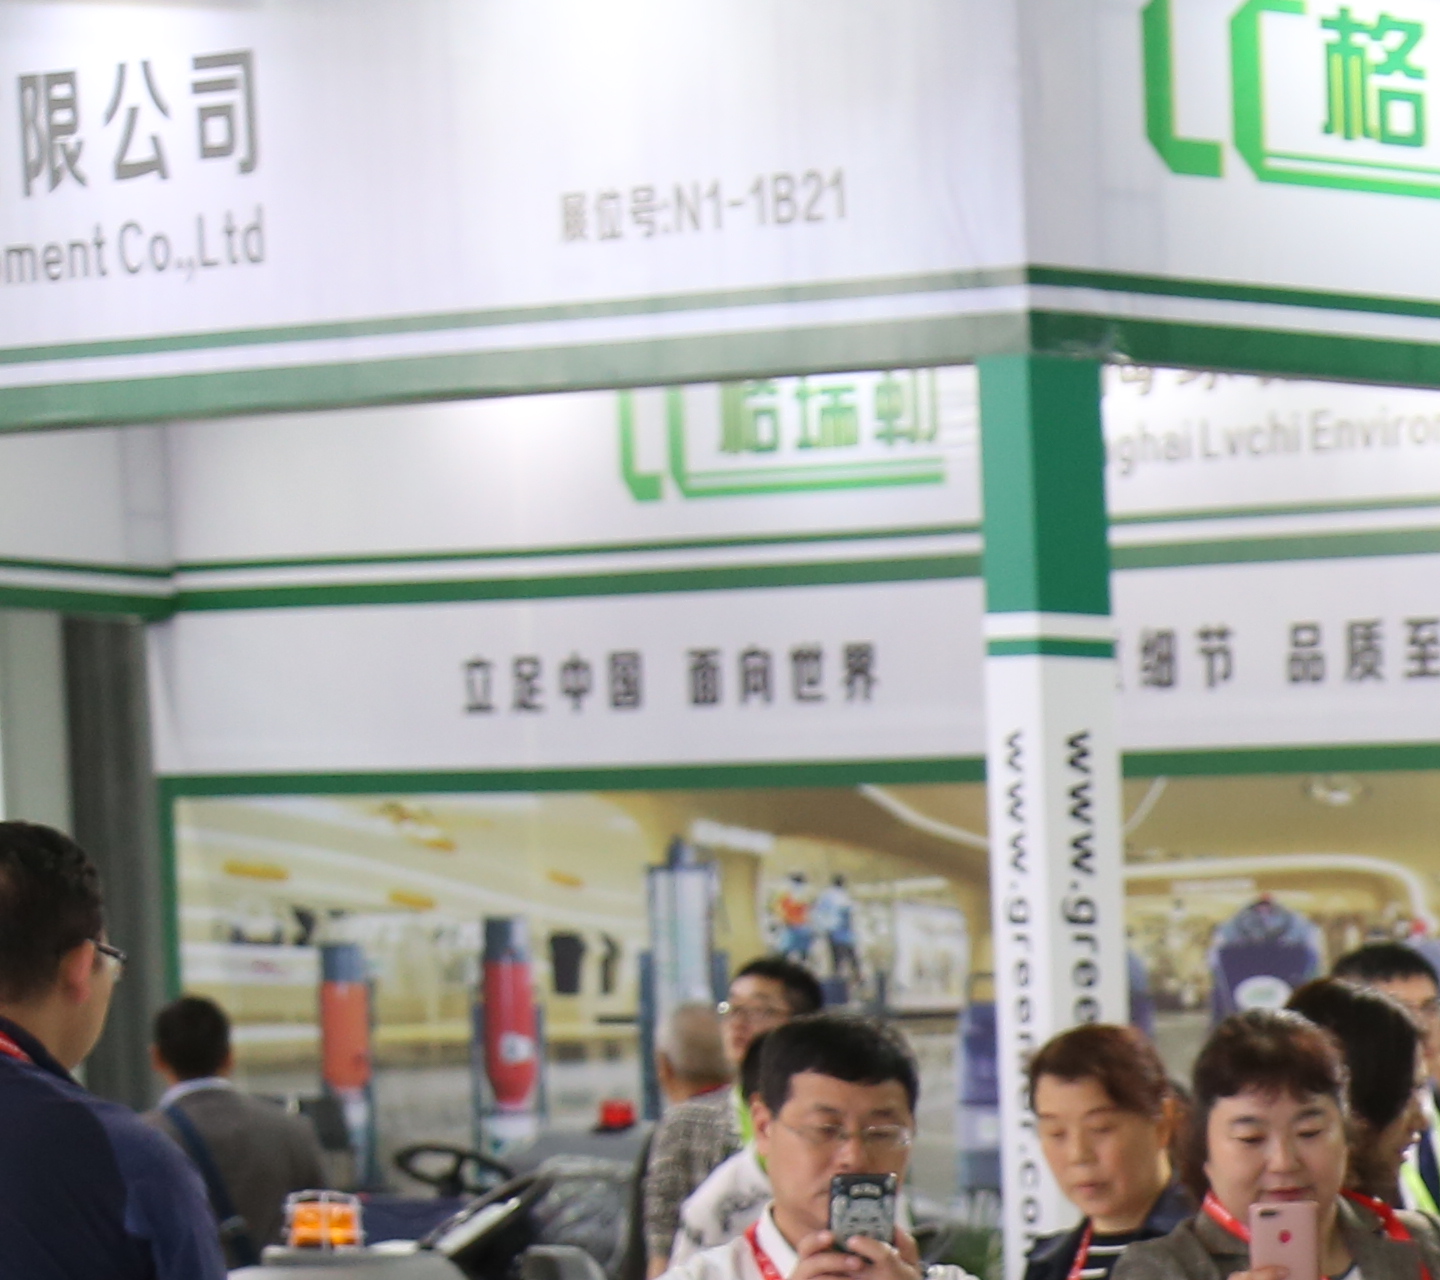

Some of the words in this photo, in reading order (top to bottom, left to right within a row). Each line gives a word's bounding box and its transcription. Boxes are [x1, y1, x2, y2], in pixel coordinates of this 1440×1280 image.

[17, 50, 257, 198] 限公司
[559, 167, 848, 244] 展位号:N1-1B21
[462, 649, 646, 716] 立足中国
[686, 641, 880, 708] 面向世界
[1114, 620, 1235, 689] 细节
